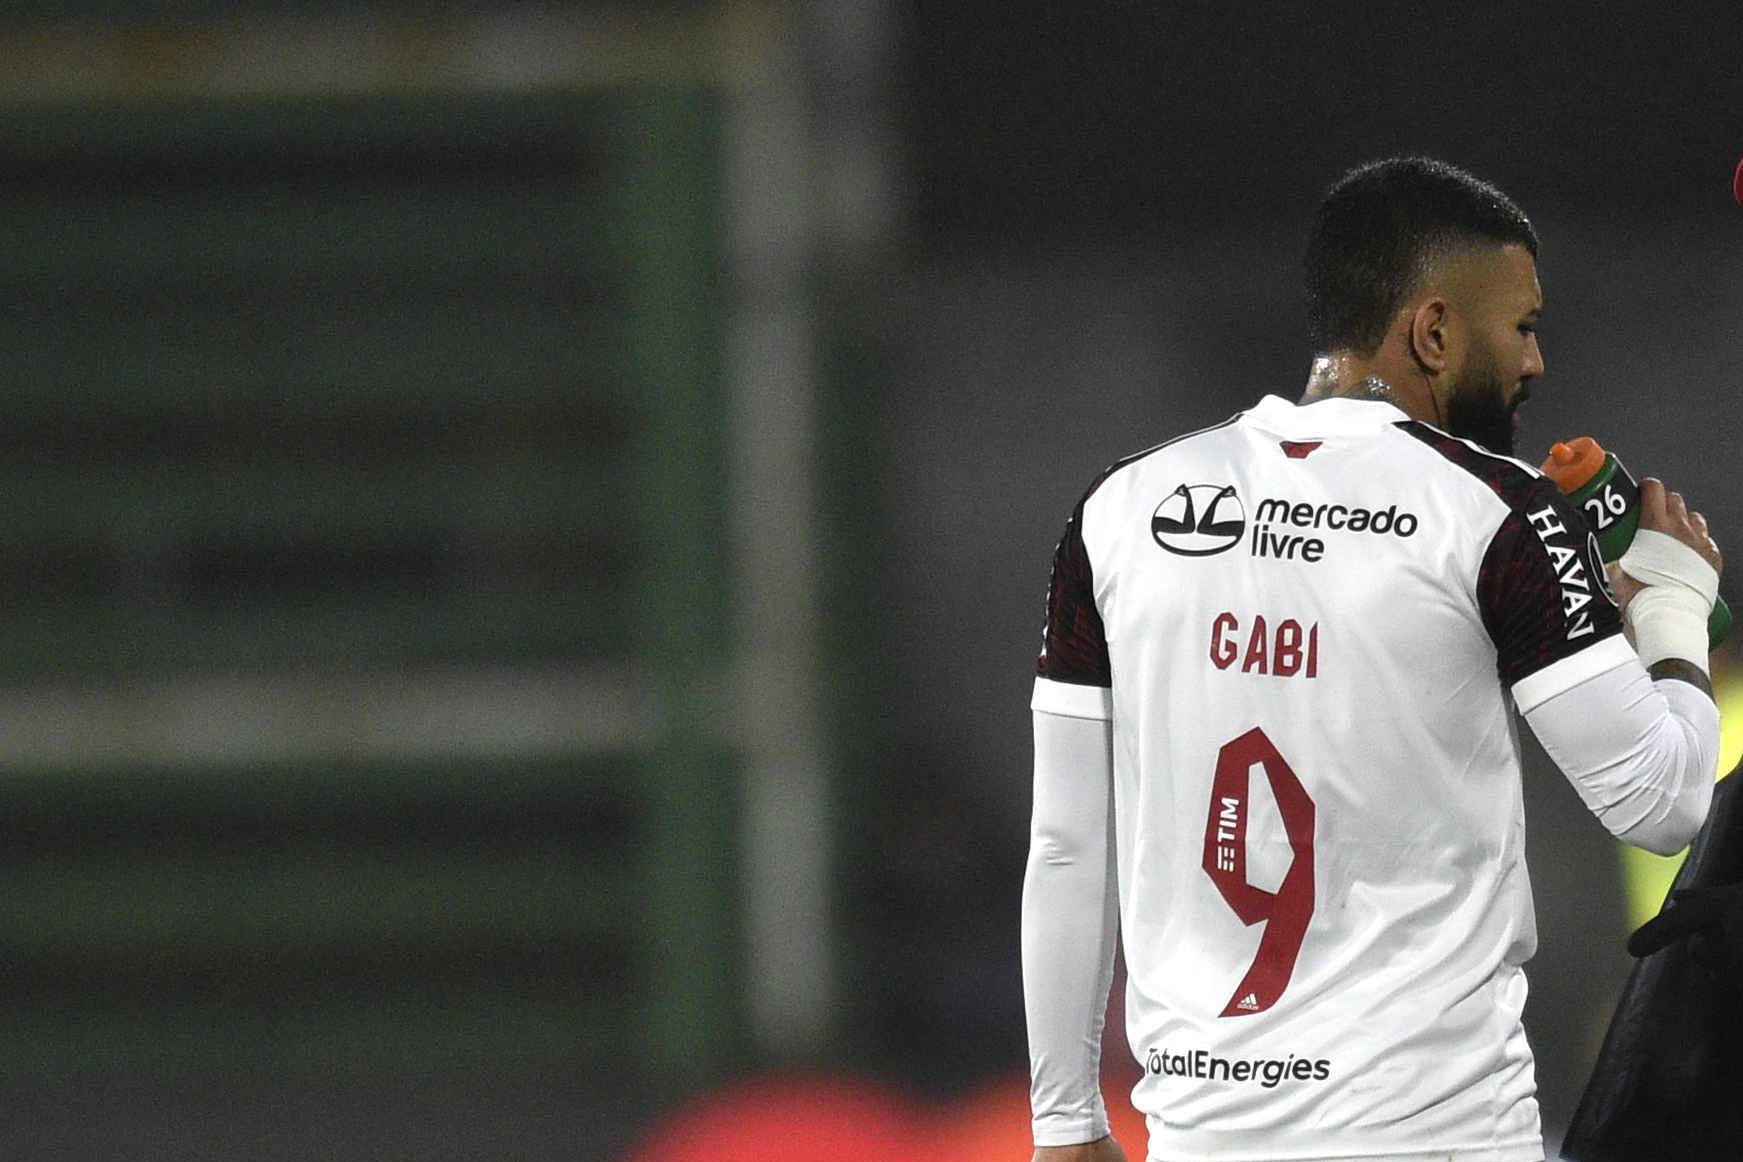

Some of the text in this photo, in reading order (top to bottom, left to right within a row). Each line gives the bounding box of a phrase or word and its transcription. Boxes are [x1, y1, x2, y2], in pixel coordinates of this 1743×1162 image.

[1255, 498, 1418, 538] mercado
[1584, 484, 1626, 530] 26
[1251, 523, 1325, 563] livre
[1526, 503, 1595, 641] HAVAN
[1209, 611, 1319, 679] GABI
[1217, 797, 1240, 843] TIM
[1201, 725, 1316, 1018] 9
[1146, 1047, 1331, 1089] TotalEnergies
